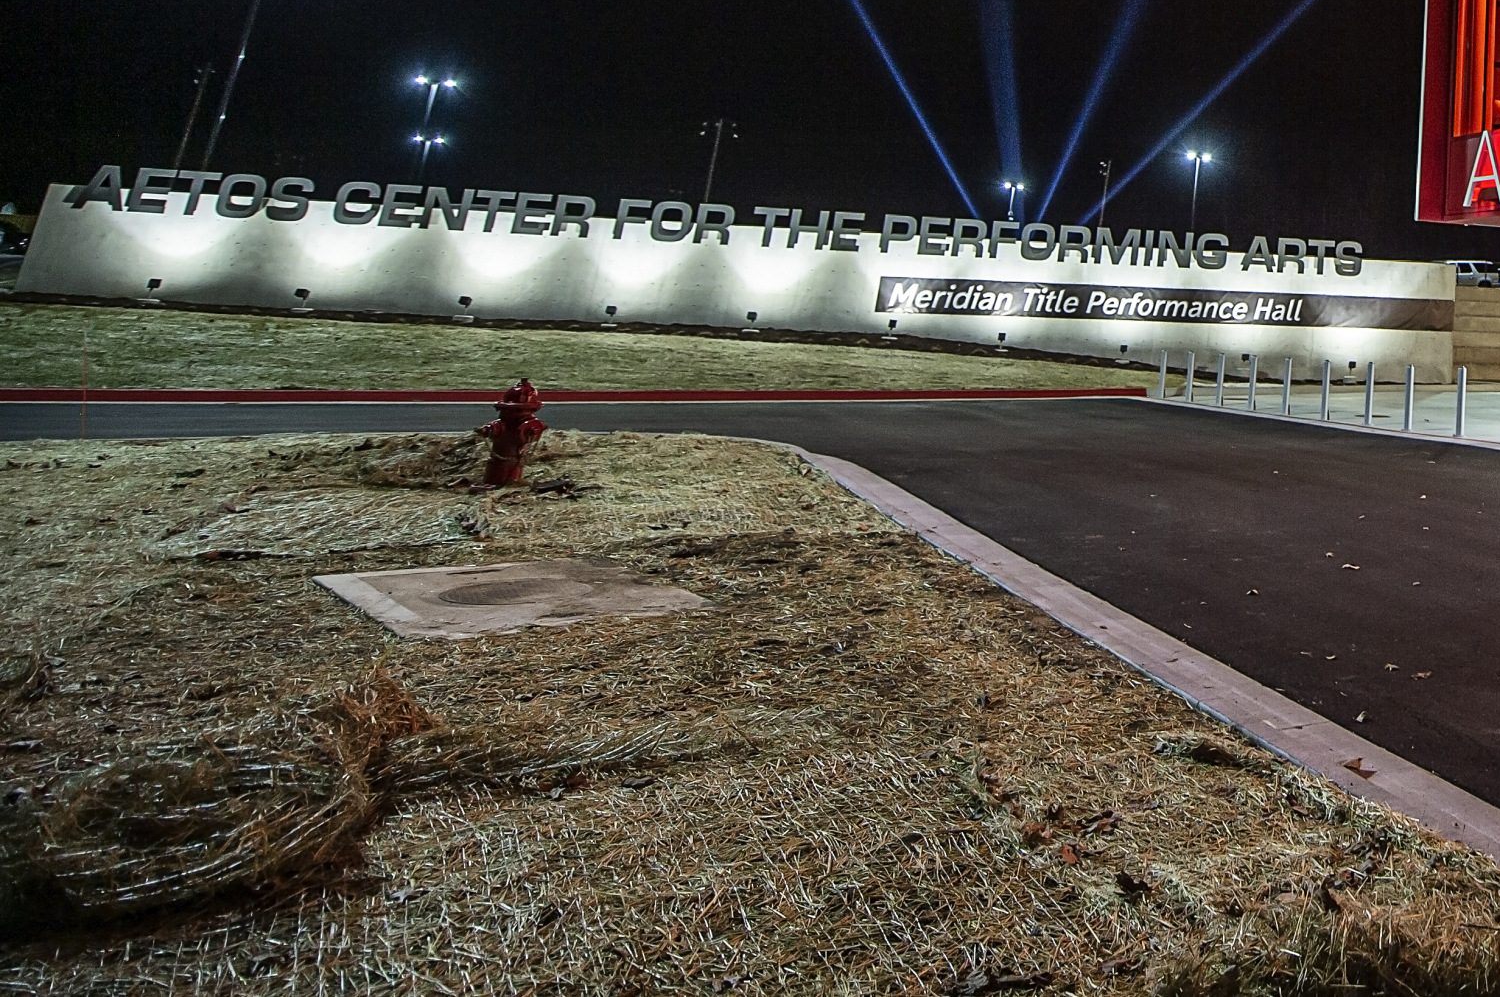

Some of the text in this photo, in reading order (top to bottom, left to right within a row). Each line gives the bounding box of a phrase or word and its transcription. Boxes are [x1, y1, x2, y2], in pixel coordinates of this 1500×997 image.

[72, 164, 1364, 277] AETOS CENTER FOR THE PERFORMING ARTS
[888, 283, 1303, 323] Meridian Title Performance Hall
